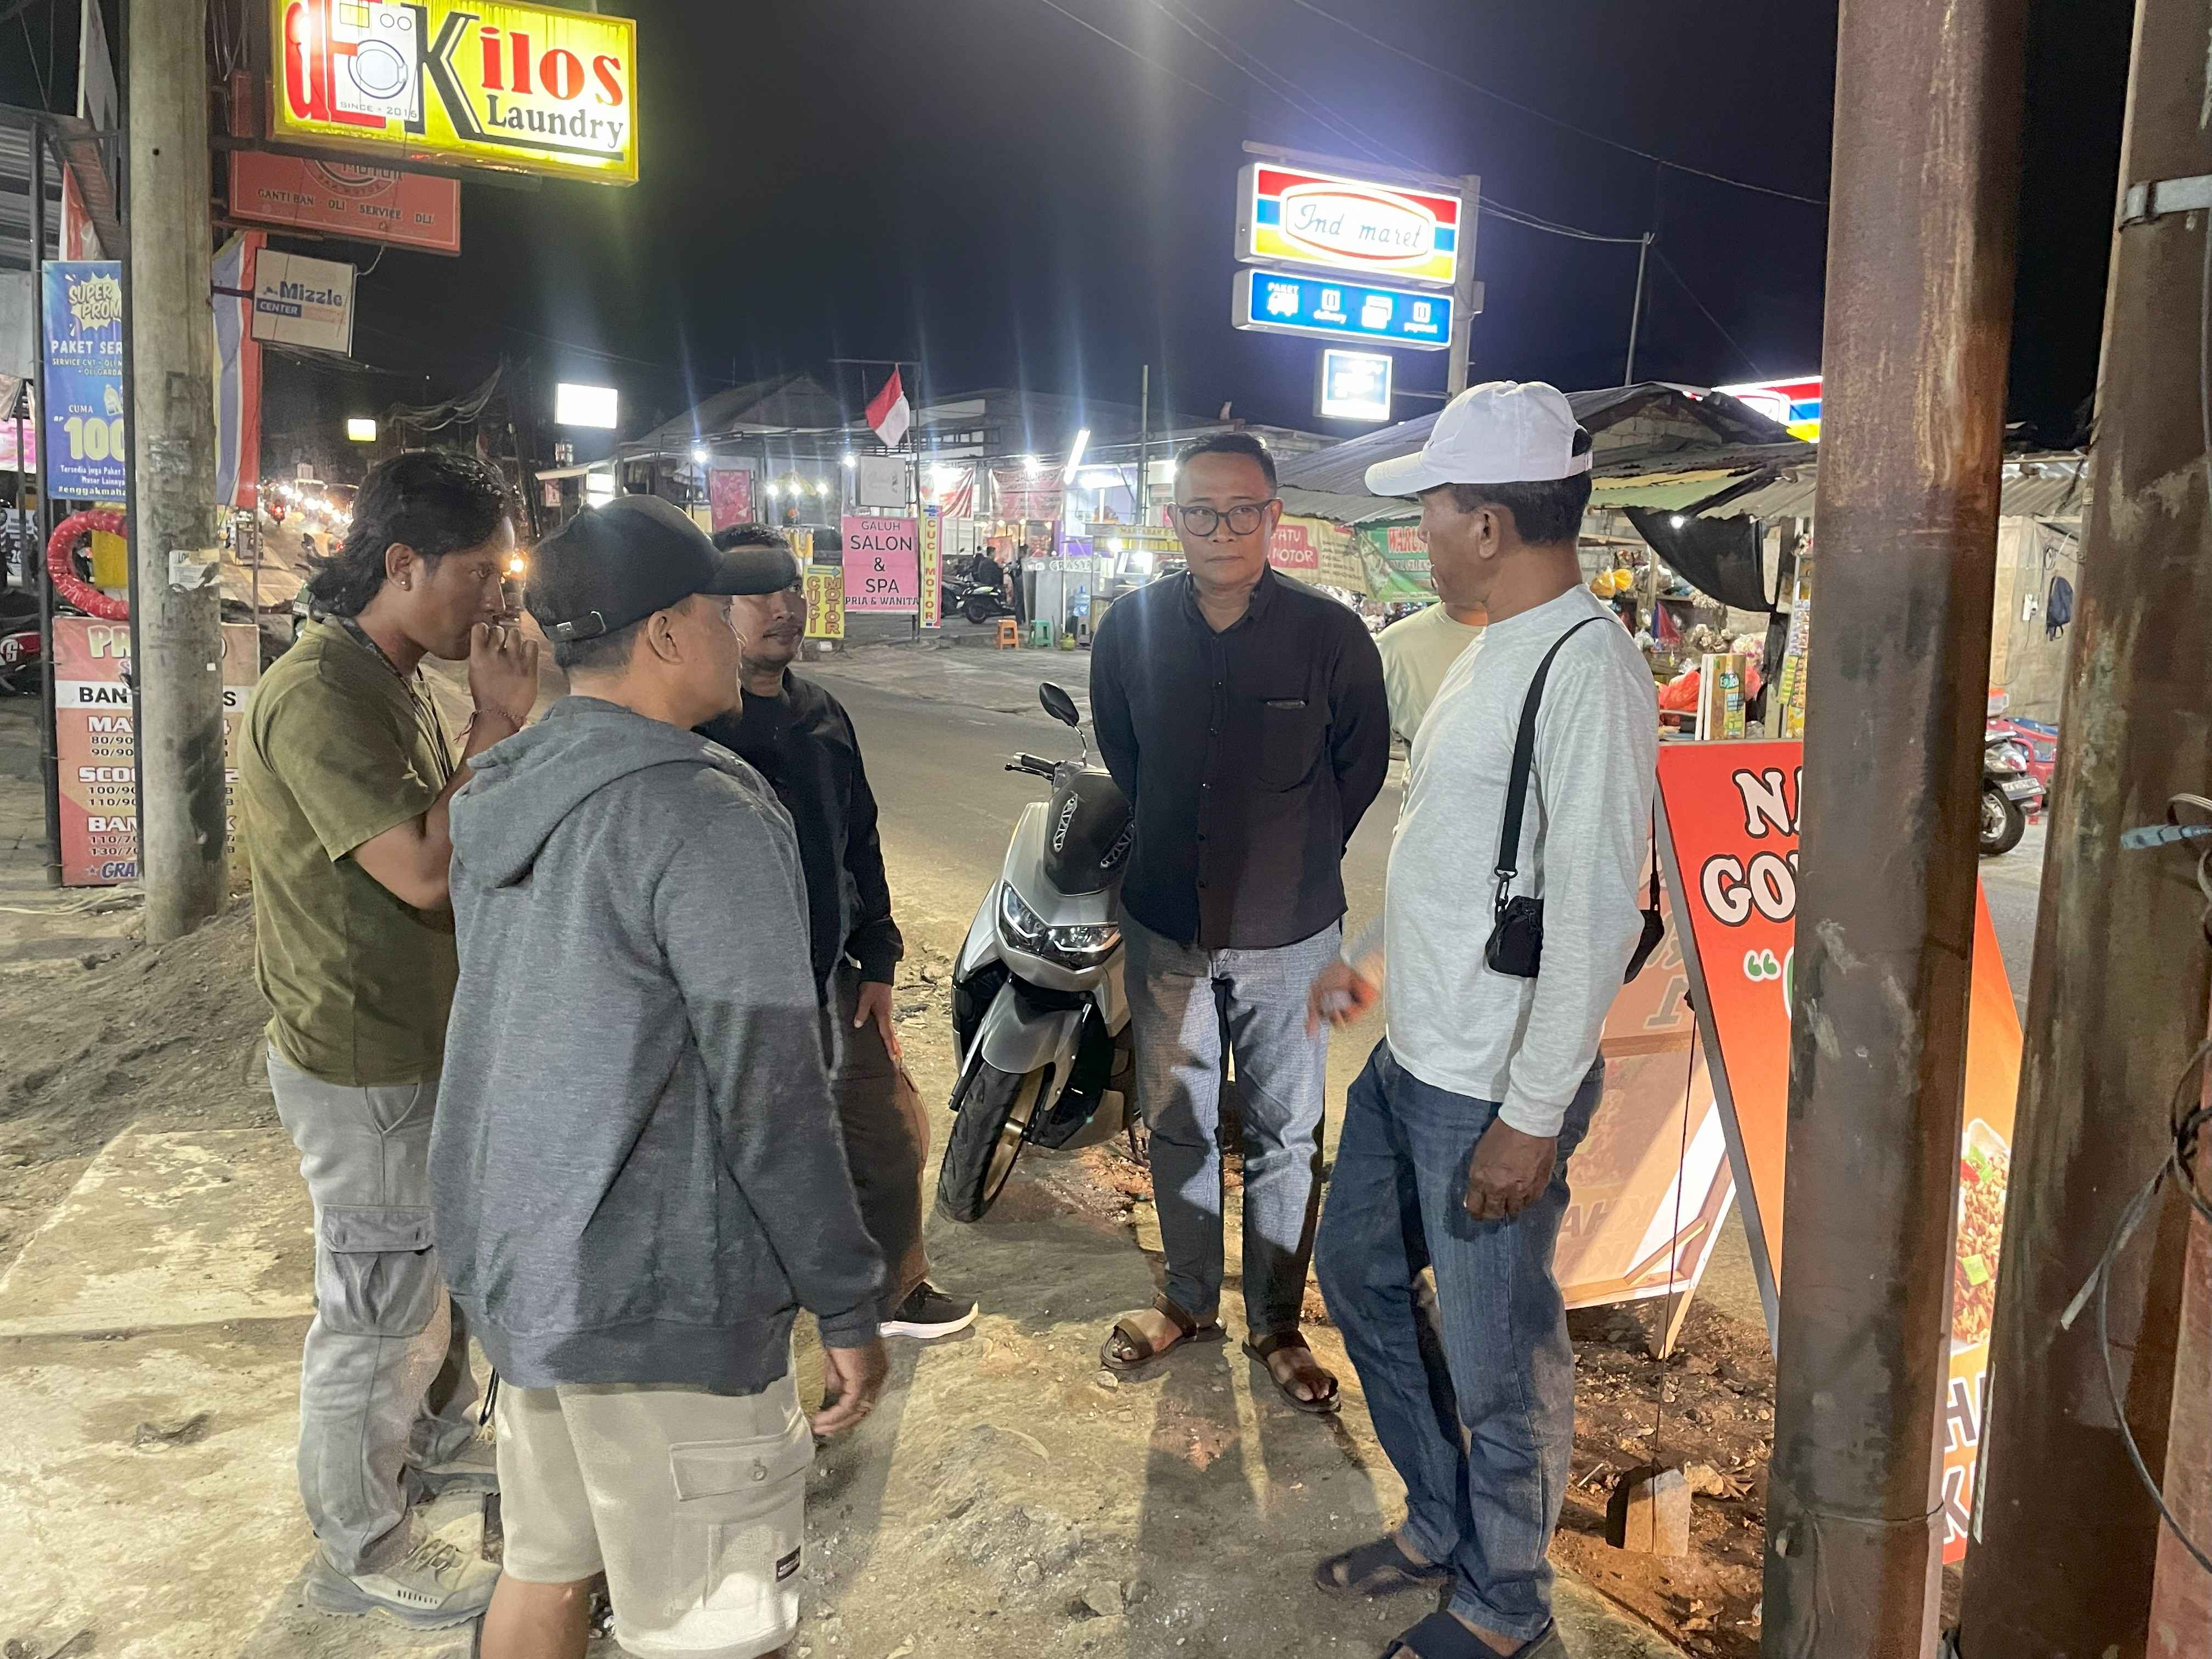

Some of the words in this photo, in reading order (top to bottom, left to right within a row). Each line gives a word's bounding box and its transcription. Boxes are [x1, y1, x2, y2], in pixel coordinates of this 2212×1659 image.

[400, 2, 623, 139] Kilos
[340, 101, 373, 112] SINCE
[386, 107, 417, 119] 2016
[486, 94, 623, 148] Laundry
[258, 189, 290, 202] GANTI
[293, 195, 314, 205] BAN
[328, 199, 346, 210] OLI
[359, 204, 402, 219] SERVICE
[69, 283, 112, 304] SUPER
[280, 281, 342, 307] Mizzle
[81, 299, 122, 319] PROM
[259, 301, 298, 315] CENTER
[52, 340, 93, 354] PAKET
[99, 341, 123, 354] SER
[52, 358, 80, 366] SERVICE
[69, 405, 94, 414] CUMA
[64, 417, 125, 462] 100
[861, 521, 901, 531] GALUH
[850, 535, 912, 551] SALON
[927, 520, 936, 561] CUCI
[874, 557, 886, 572] &
[865, 578, 900, 594] SPA
[925, 568, 935, 620] MOTOR
[806, 576, 821, 634] CUCI
[824, 577, 843, 634] MOTOR
[845, 596, 867, 605] PRIA
[871, 596, 877, 605] &
[880, 597, 919, 606] WANITA
[91, 736, 133, 744] 80/90
[91, 748, 133, 757] 90/90
[88, 786, 136, 794] 100/90
[89, 798, 136, 806] 110/90
